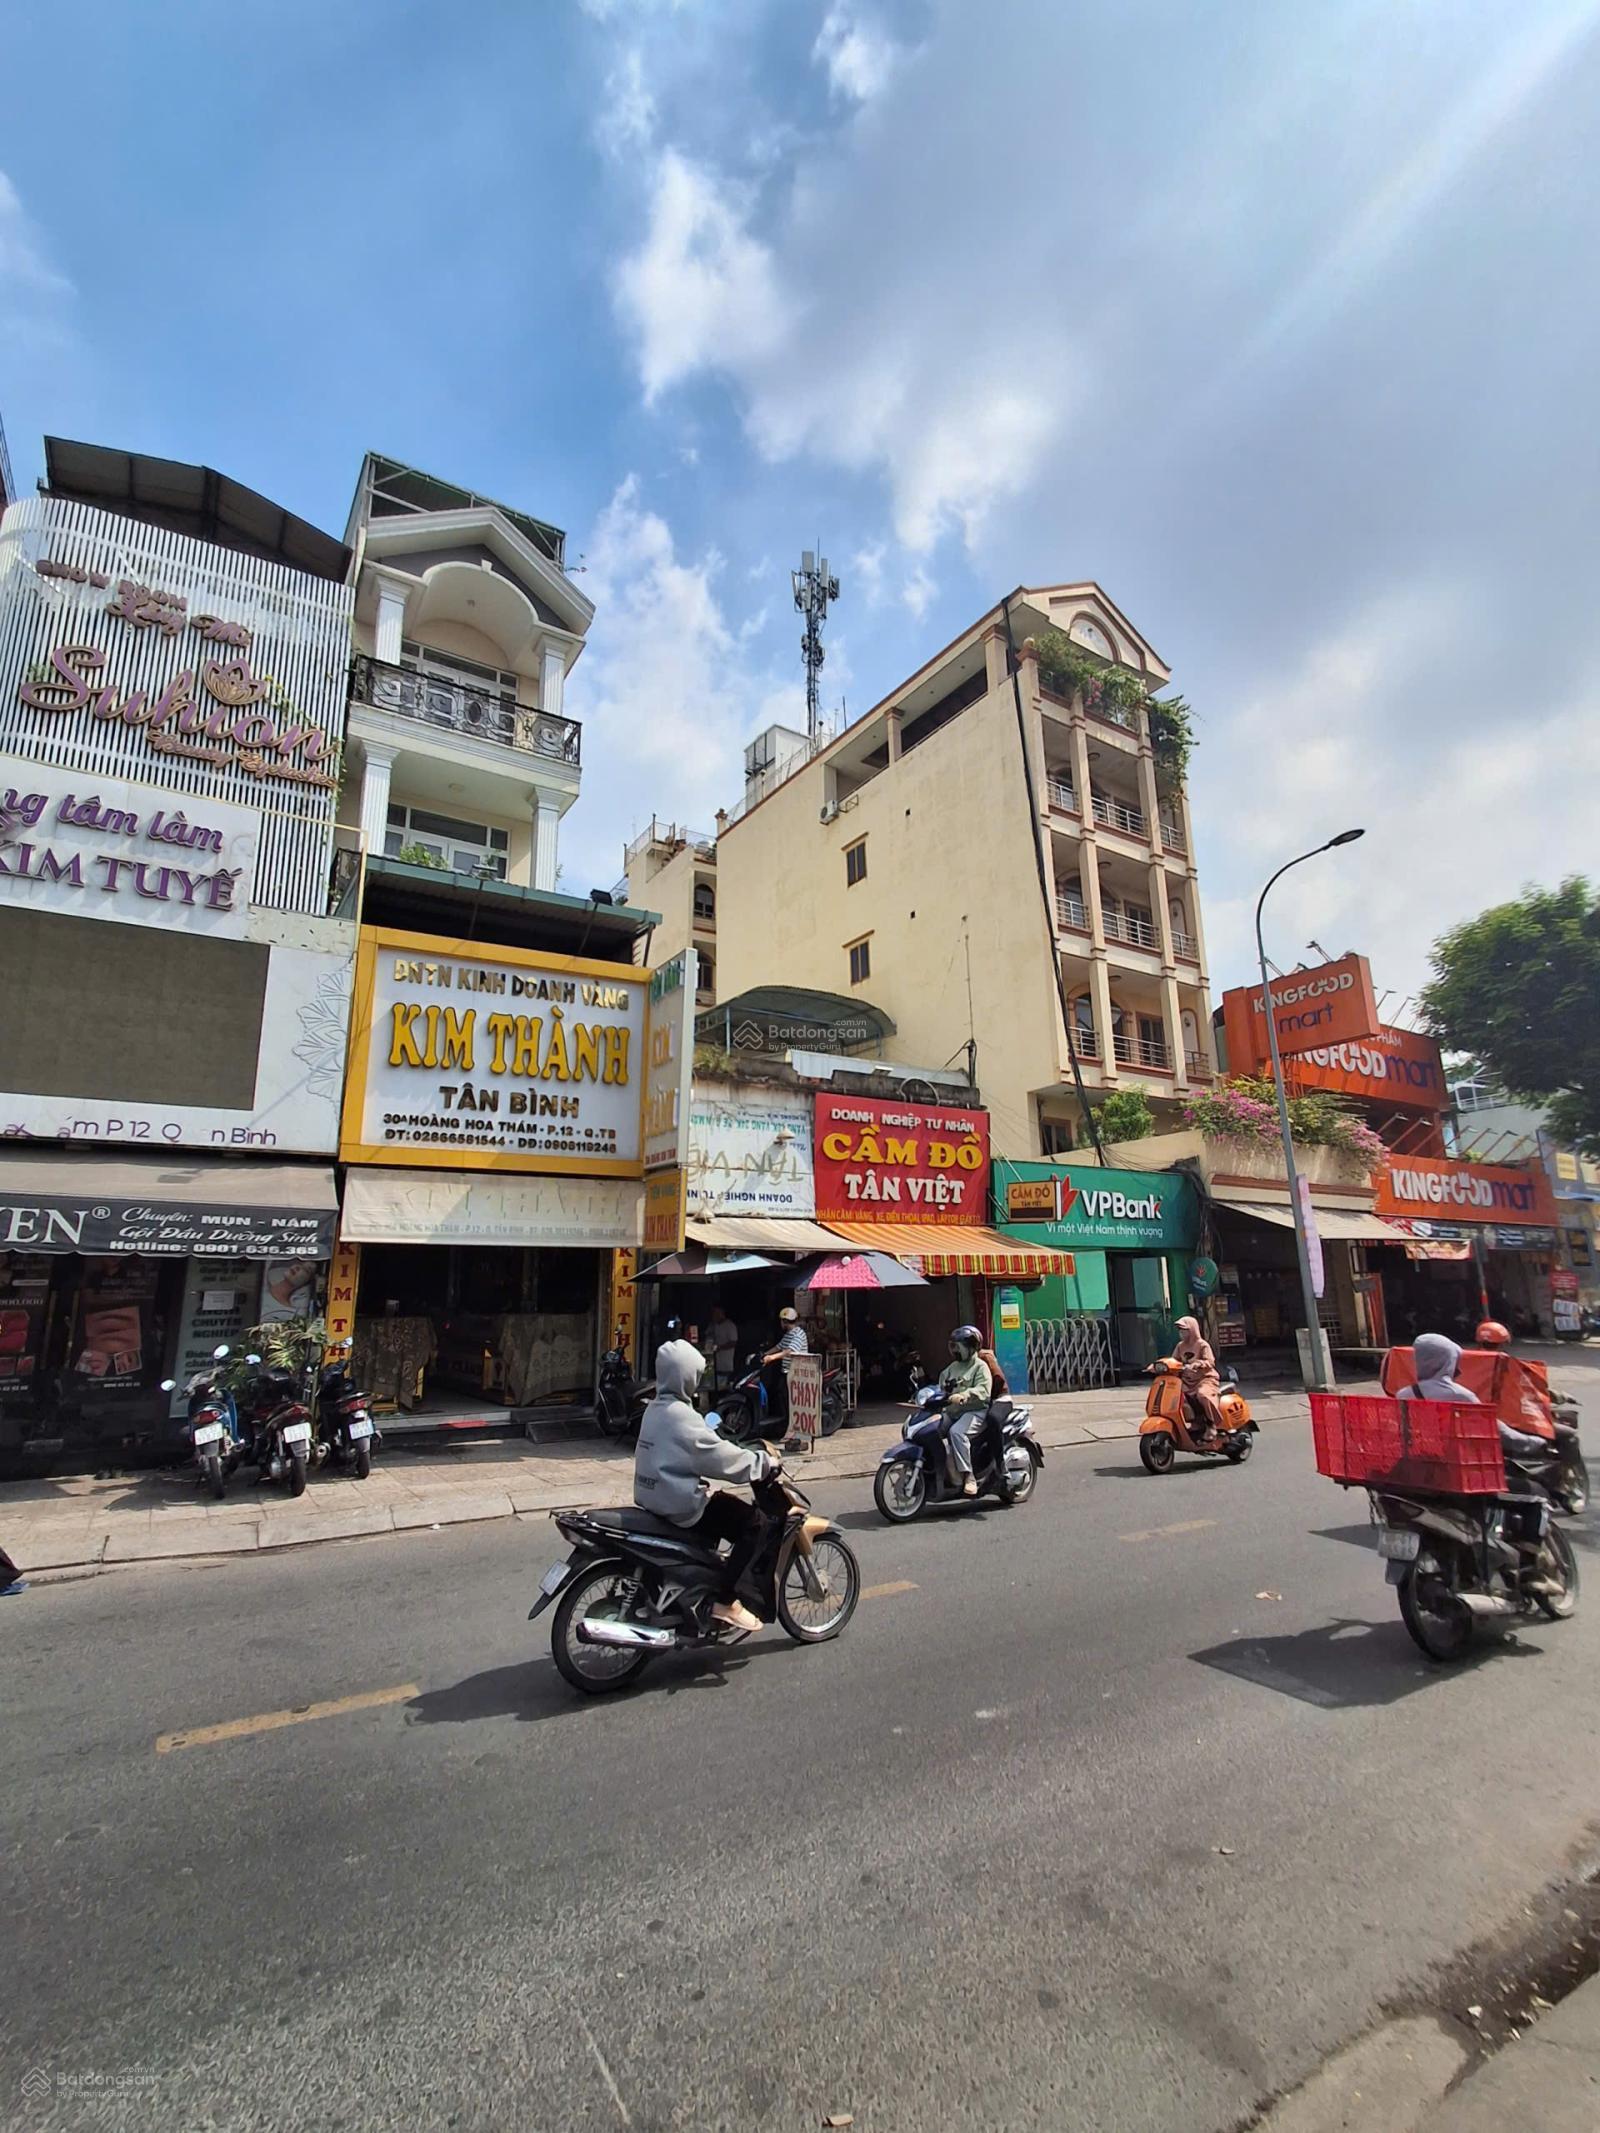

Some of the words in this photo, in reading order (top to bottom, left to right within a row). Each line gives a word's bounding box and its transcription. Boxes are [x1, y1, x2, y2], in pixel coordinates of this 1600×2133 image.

[57, 794, 138, 836] tâm
[394, 959, 453, 988] DNTN
[457, 967, 506, 995] KINH
[511, 975, 575, 1004] DOANH
[580, 981, 630, 1011] VÀNG
[1253, 973, 1354, 1013] KNGFOOD
[1279, 1002, 1334, 1034] mart
[388, 1002, 477, 1070] KIM
[487, 1005, 631, 1086] THÀNH
[438, 1082, 500, 1112] TÂN
[508, 1088, 581, 1118] BÌNH
[408, 1114, 460, 1129] HOÀNG
[465, 1119, 494, 1131] HOA
[498, 1120, 537, 1134] THÁM
[832, 1108, 874, 1123] DOANH
[882, 1113, 922, 1130] NGHIỆP
[926, 1118, 943, 1129] TƯ
[945, 1119, 975, 1132] NHÂN
[231, 1127, 276, 1145] Bình
[823, 1124, 919, 1165] CẦM
[928, 1132, 984, 1170] ĐỒ
[758, 1193, 793, 1203] DOANH
[844, 1169, 901, 1201] TÂN
[906, 1173, 965, 1211] VIỆT
[1081, 1189, 1163, 1219] VPBank
[201, 1215, 250, 1227] MỤN
[1077, 1223, 1094, 1236] Việt
[1095, 1224, 1115, 1234] Nam
[109, 1240, 188, 1252] Hotline:
[277, 1231, 318, 1244] Sinh
[790, 1381, 818, 1409] CHAY
[793, 1411, 817, 1435] 20K
